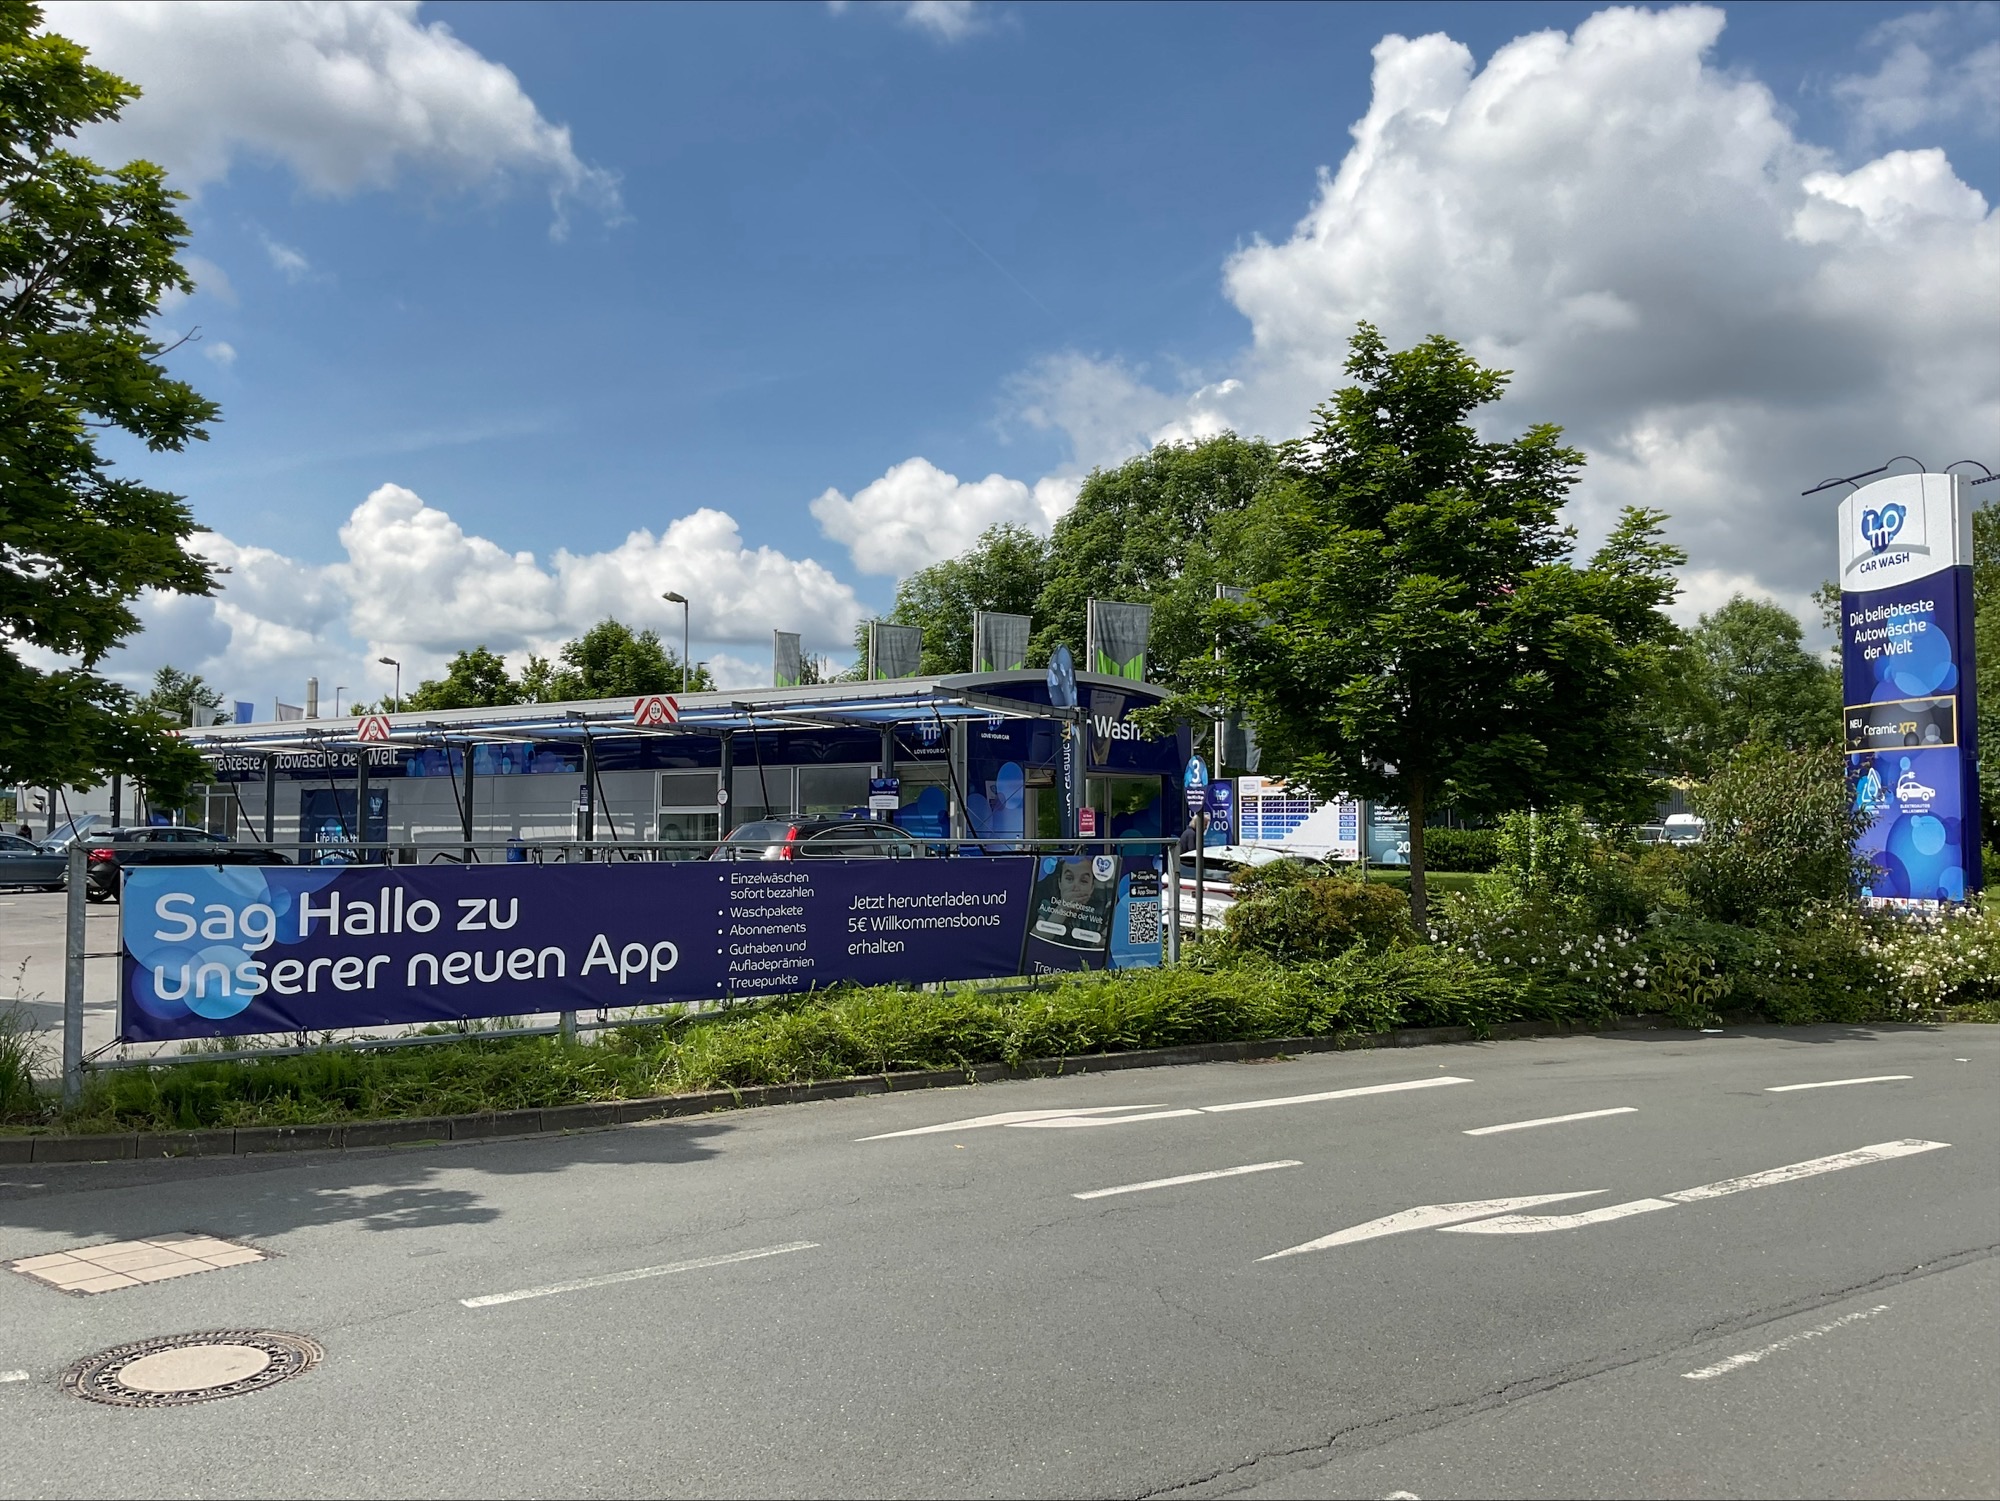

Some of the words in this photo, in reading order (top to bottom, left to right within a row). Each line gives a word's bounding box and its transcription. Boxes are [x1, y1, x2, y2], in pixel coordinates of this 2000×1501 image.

[1859, 560, 1877, 574] CAR
[1878, 552, 1910, 569] WASH
[1850, 612, 1864, 627] Die
[1865, 600, 1935, 622] beliebteste
[1854, 619, 1927, 644] Autowäsche
[1864, 646, 1882, 660] der
[1883, 639, 1913, 656] Welt
[1094, 714, 1141, 741] Wash
[1849, 718, 1863, 729] NEU
[1863, 722, 1897, 736] Ceramic
[1898, 721, 1918, 735] XTR
[368, 748, 399, 766] Welt
[1192, 759, 1201, 783] 3
[1212, 809, 1227, 819] HD
[730, 872, 809, 885] Einzelwäschen
[730, 887, 764, 900] sofort
[766, 886, 815, 899] bezahlen
[848, 894, 885, 911] Jetzt
[887, 891, 980, 909] herunterladen
[982, 889, 1007, 905] und
[1051, 896, 1062, 906] Die
[153, 892, 277, 952] Sag
[299, 886, 441, 937] Hallo
[456, 897, 518, 931] zu
[730, 904, 804, 919] Waschpakete
[1039, 903, 1078, 919] Autowäsche
[1077, 913, 1089, 921] der
[1089, 914, 1104, 925] Welt
[729, 921, 807, 937] Abonnements
[847, 916, 868, 934] 5€
[870, 912, 1001, 932] Willkommensbonus
[729, 942, 784, 956] Guthaben
[785, 939, 807, 952] und
[847, 938, 905, 955] erhalten
[153, 954, 391, 1001] unserer
[406, 946, 566, 987] neuen
[580, 933, 679, 985] App
[729, 956, 815, 972] Aufladeprämien
[728, 974, 799, 990] Treuepunkte
